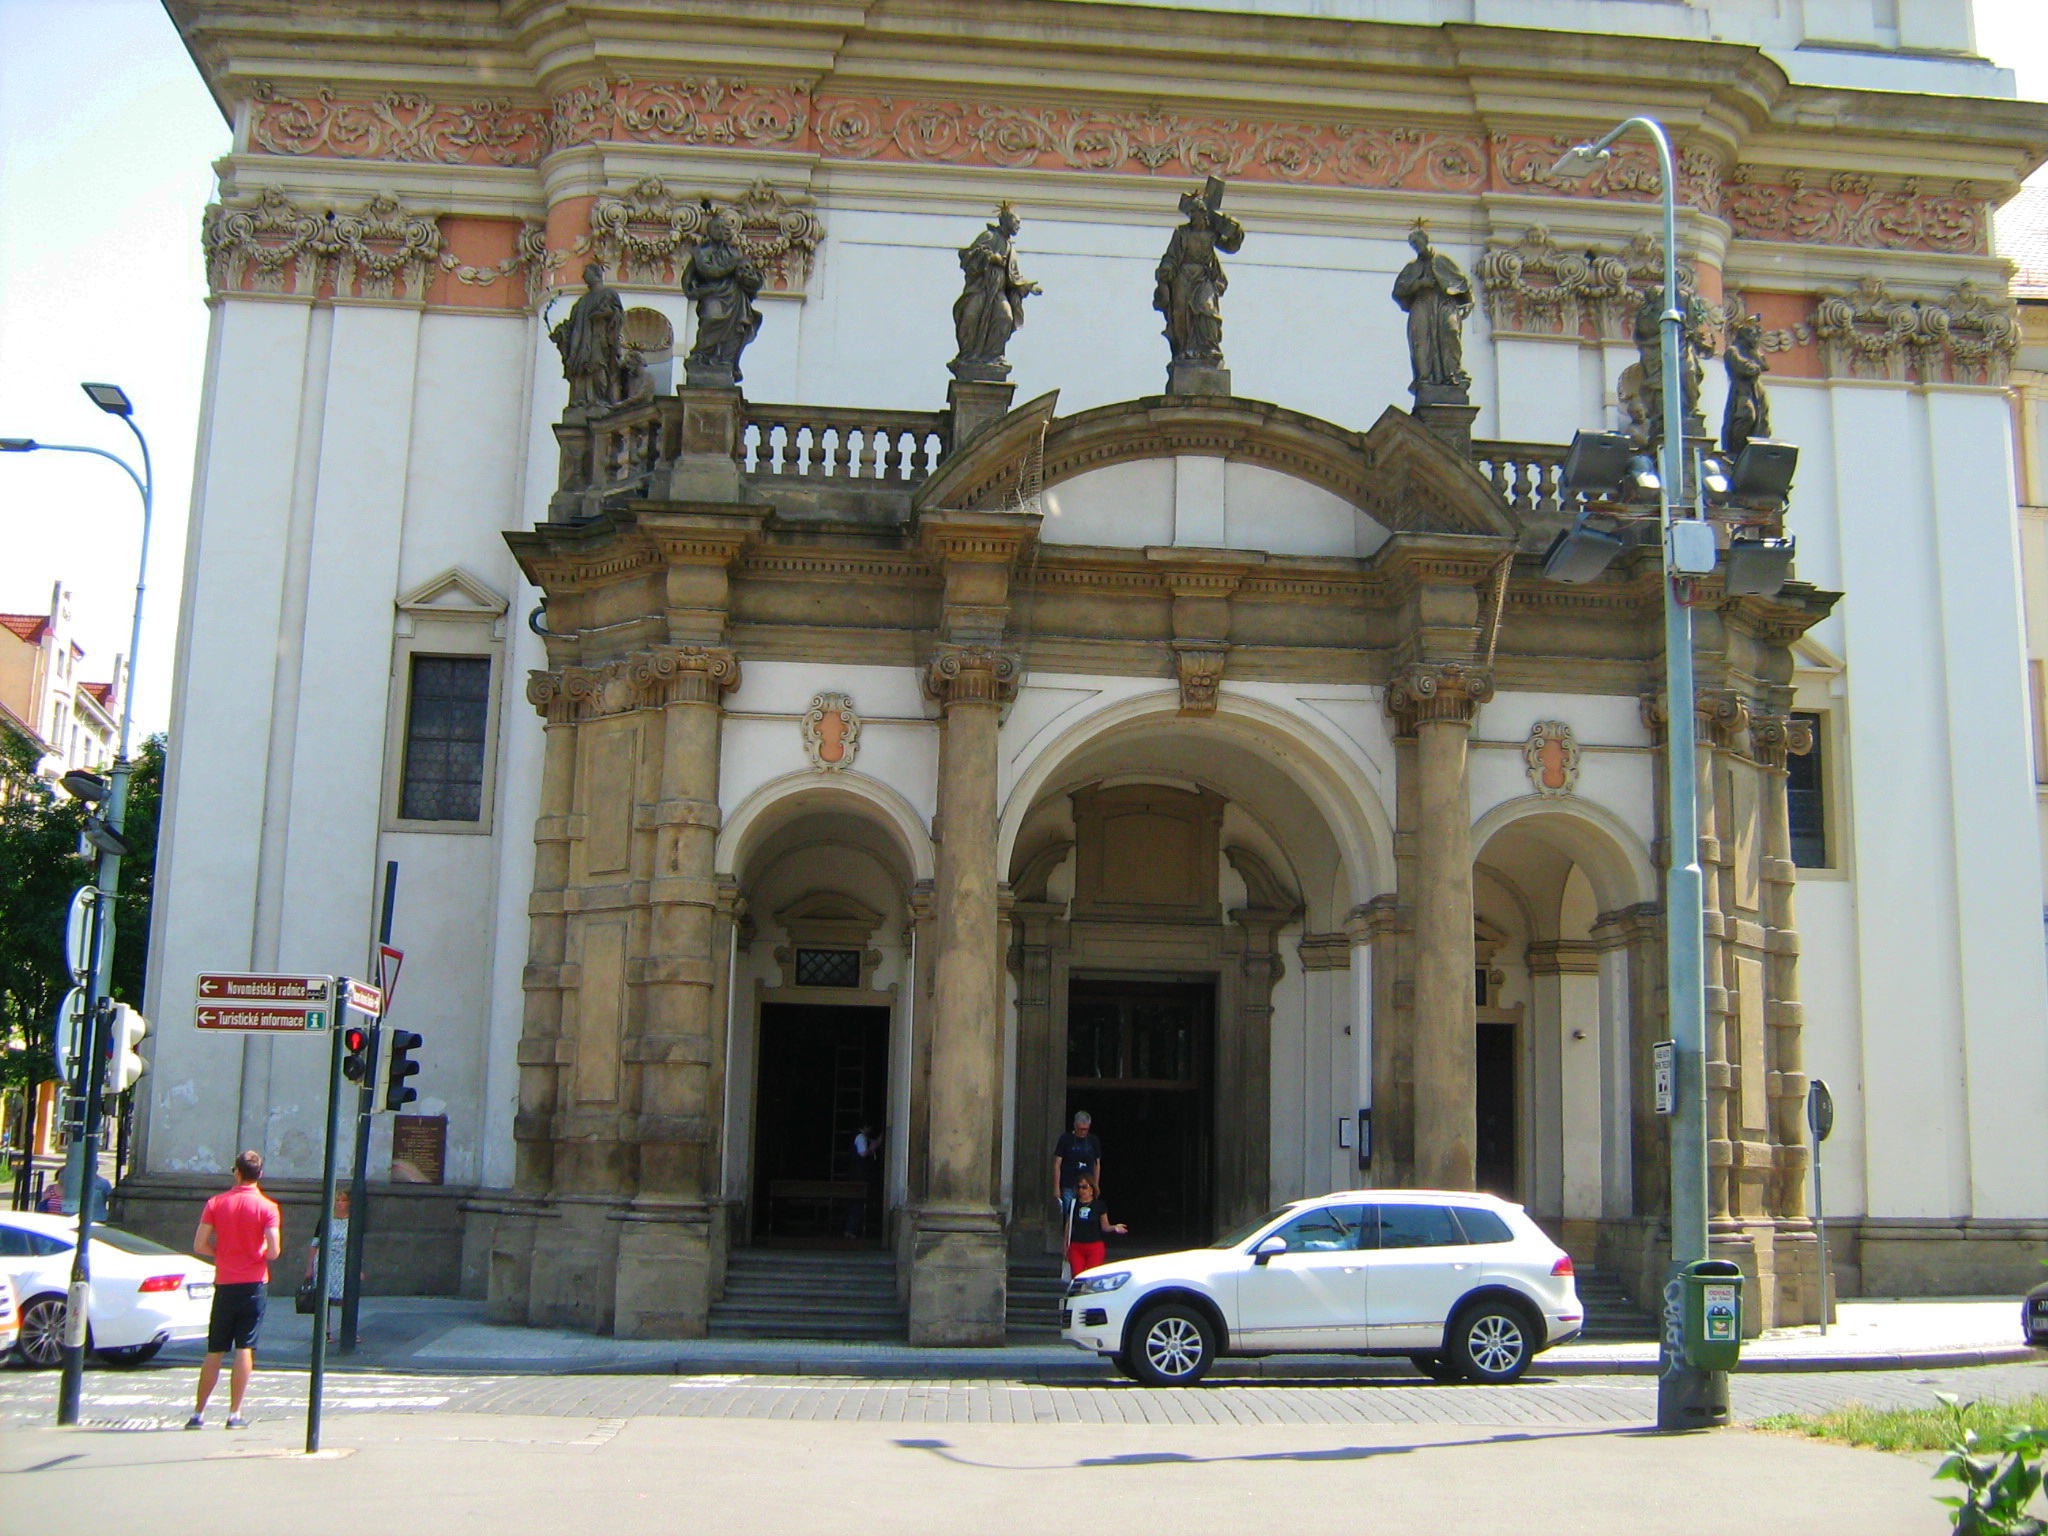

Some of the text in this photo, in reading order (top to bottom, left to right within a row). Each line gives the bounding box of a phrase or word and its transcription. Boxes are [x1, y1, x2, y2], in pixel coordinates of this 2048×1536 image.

[227, 981, 306, 997] Novoměstská radnice
[218, 1010, 304, 1028] Turistické informace
